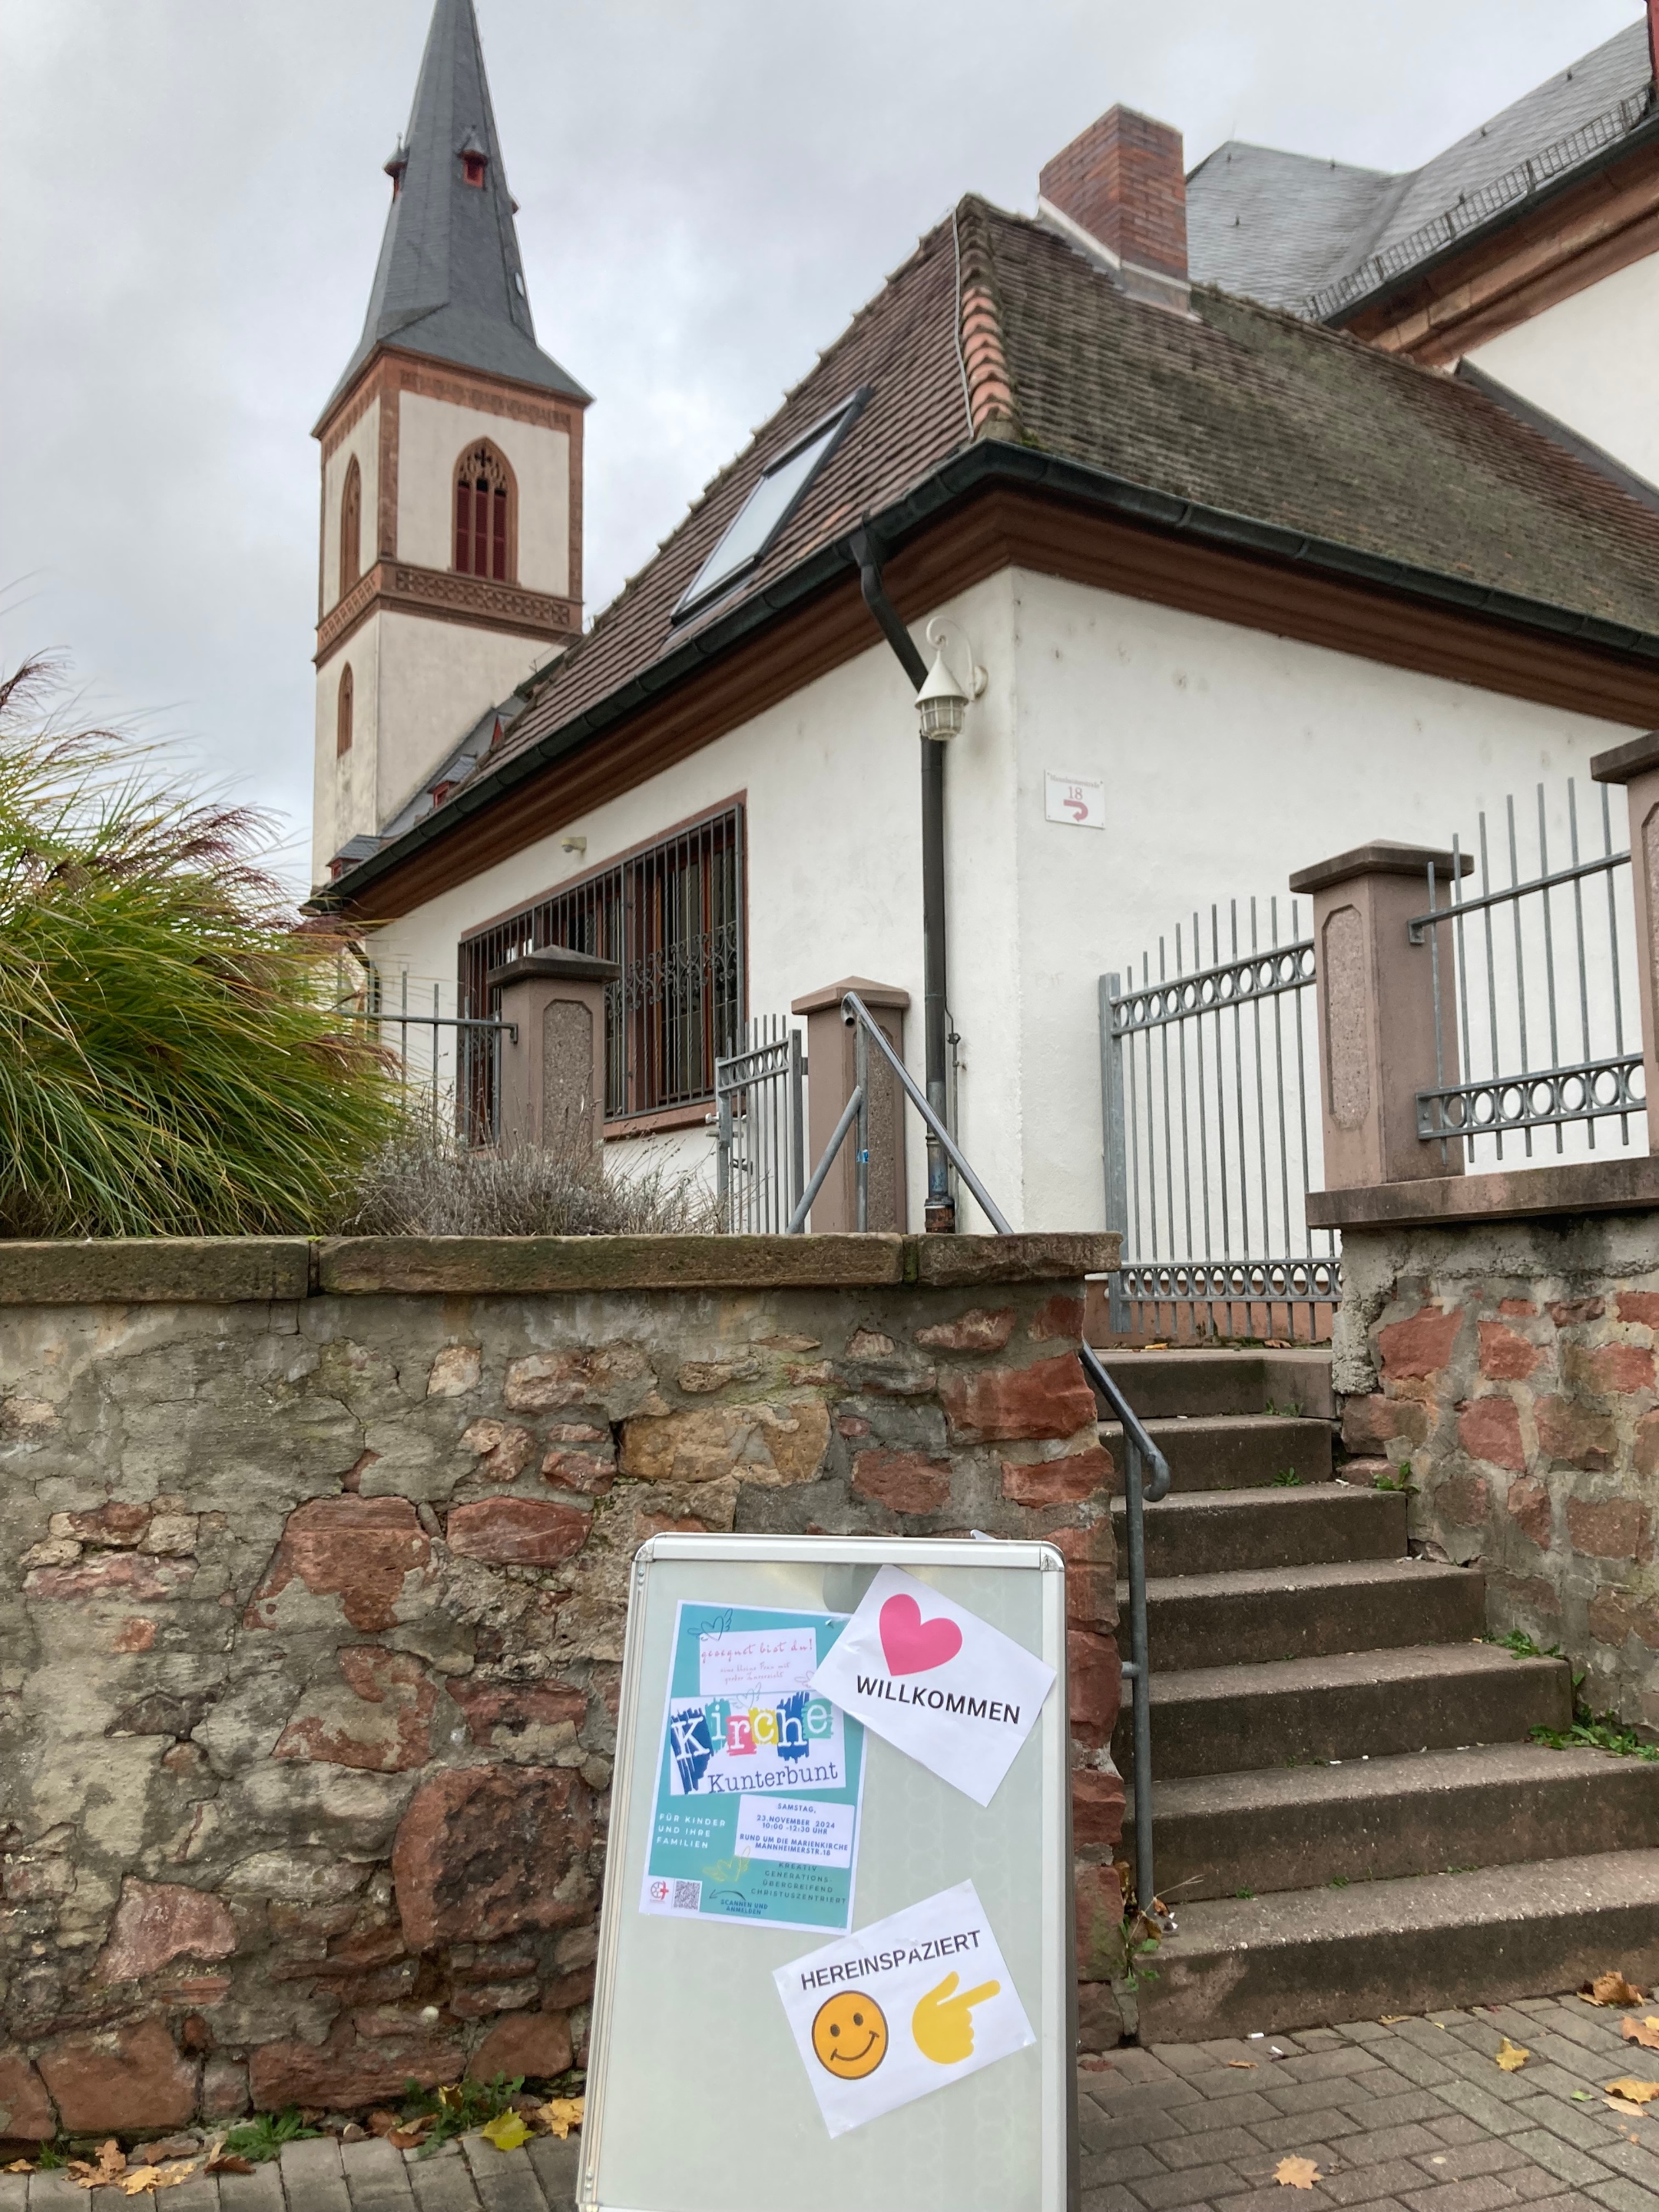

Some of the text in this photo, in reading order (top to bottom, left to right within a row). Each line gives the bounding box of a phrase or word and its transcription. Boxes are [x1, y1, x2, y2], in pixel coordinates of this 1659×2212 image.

[1068, 786, 1083, 800] 18
[760, 1641, 786, 1653] bist
[791, 1638, 813, 1651] du!
[856, 1675, 1021, 1724] WILLKOMMEN
[671, 1704, 828, 1760] Kirche
[707, 1762, 838, 1793] Kunterbunt
[777, 1803, 816, 1813] SAMSTAG,
[660, 1813, 726, 1826] FÜR KINDER
[815, 1820, 835, 1829] 2024
[658, 1825, 710, 1837] UND IHRE
[657, 1836, 708, 1849] FAMILIEN
[791, 1839, 848, 1851] MARIENKIRCHE
[755, 1843, 830, 1856] MANNHEIMERSTR.18
[779, 1863, 817, 1872] KREATIV
[765, 1871, 833, 1883] GENERATIONS-
[763, 1879, 833, 1893] ÜBERGREIFEND
[750, 1889, 846, 1904] CHRISTUSZENTRIERT
[720, 1899, 753, 1908] SCANNEN
[726, 1906, 761, 1915] ANMELDEN
[801, 1929, 981, 1991] HEREINSPAZIERT
